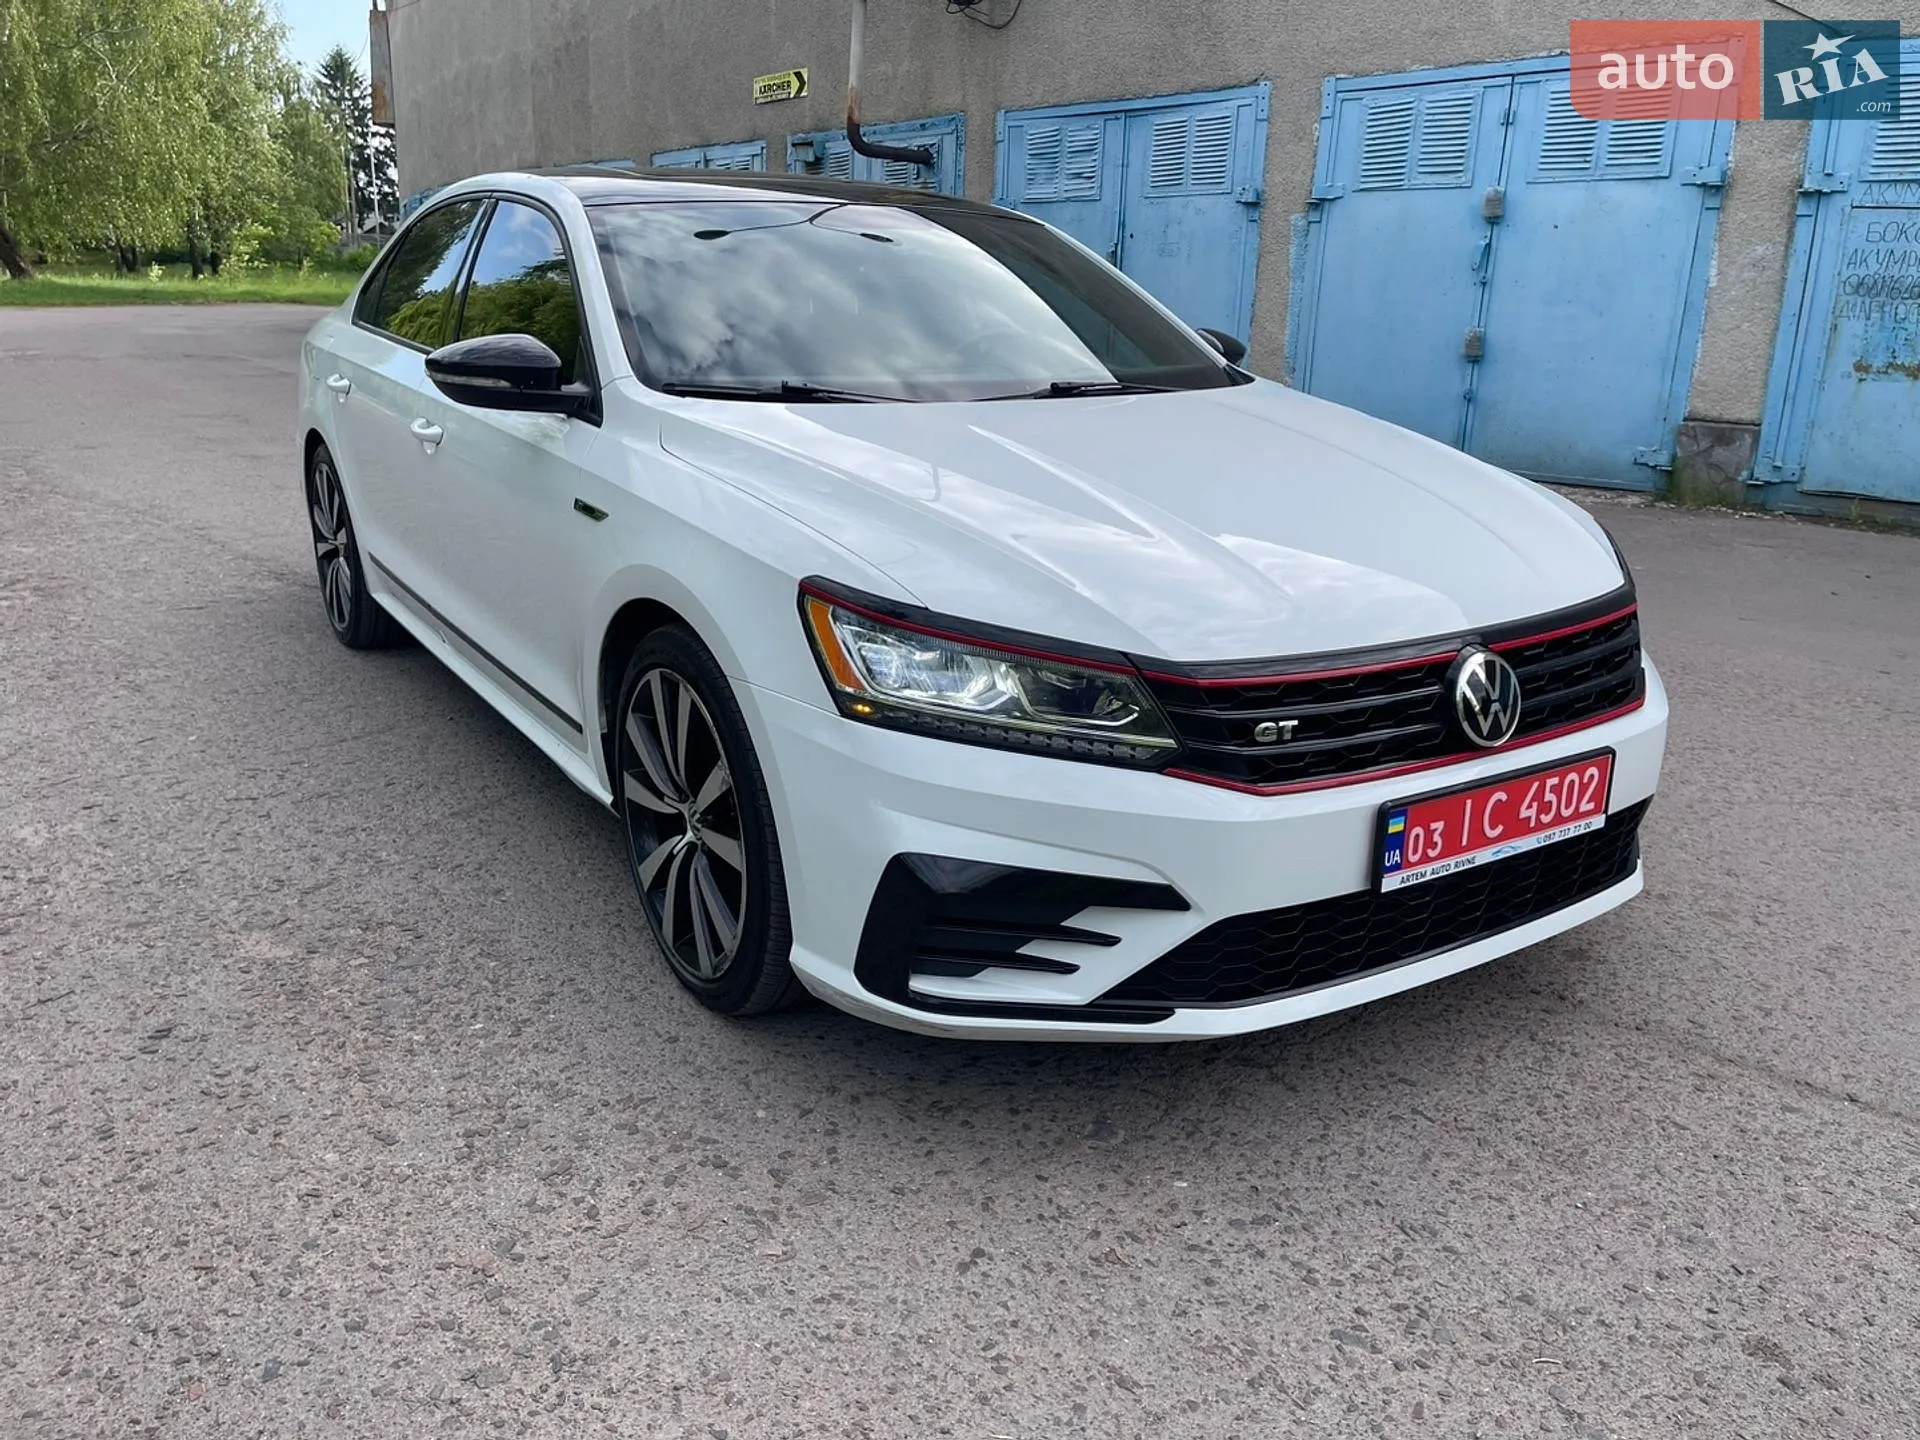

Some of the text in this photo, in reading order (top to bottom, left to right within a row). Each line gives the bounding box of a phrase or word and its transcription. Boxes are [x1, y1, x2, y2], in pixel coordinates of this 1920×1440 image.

[1254, 719, 1299, 743] GT
[1384, 849, 1401, 867] UA
[1407, 820, 1444, 863] 03
[1518, 766, 1600, 828] 4502
[1399, 870, 1427, 886] ARTEM
[1430, 863, 1451, 878] AUTO
[1453, 855, 1476, 870] RIVNE
